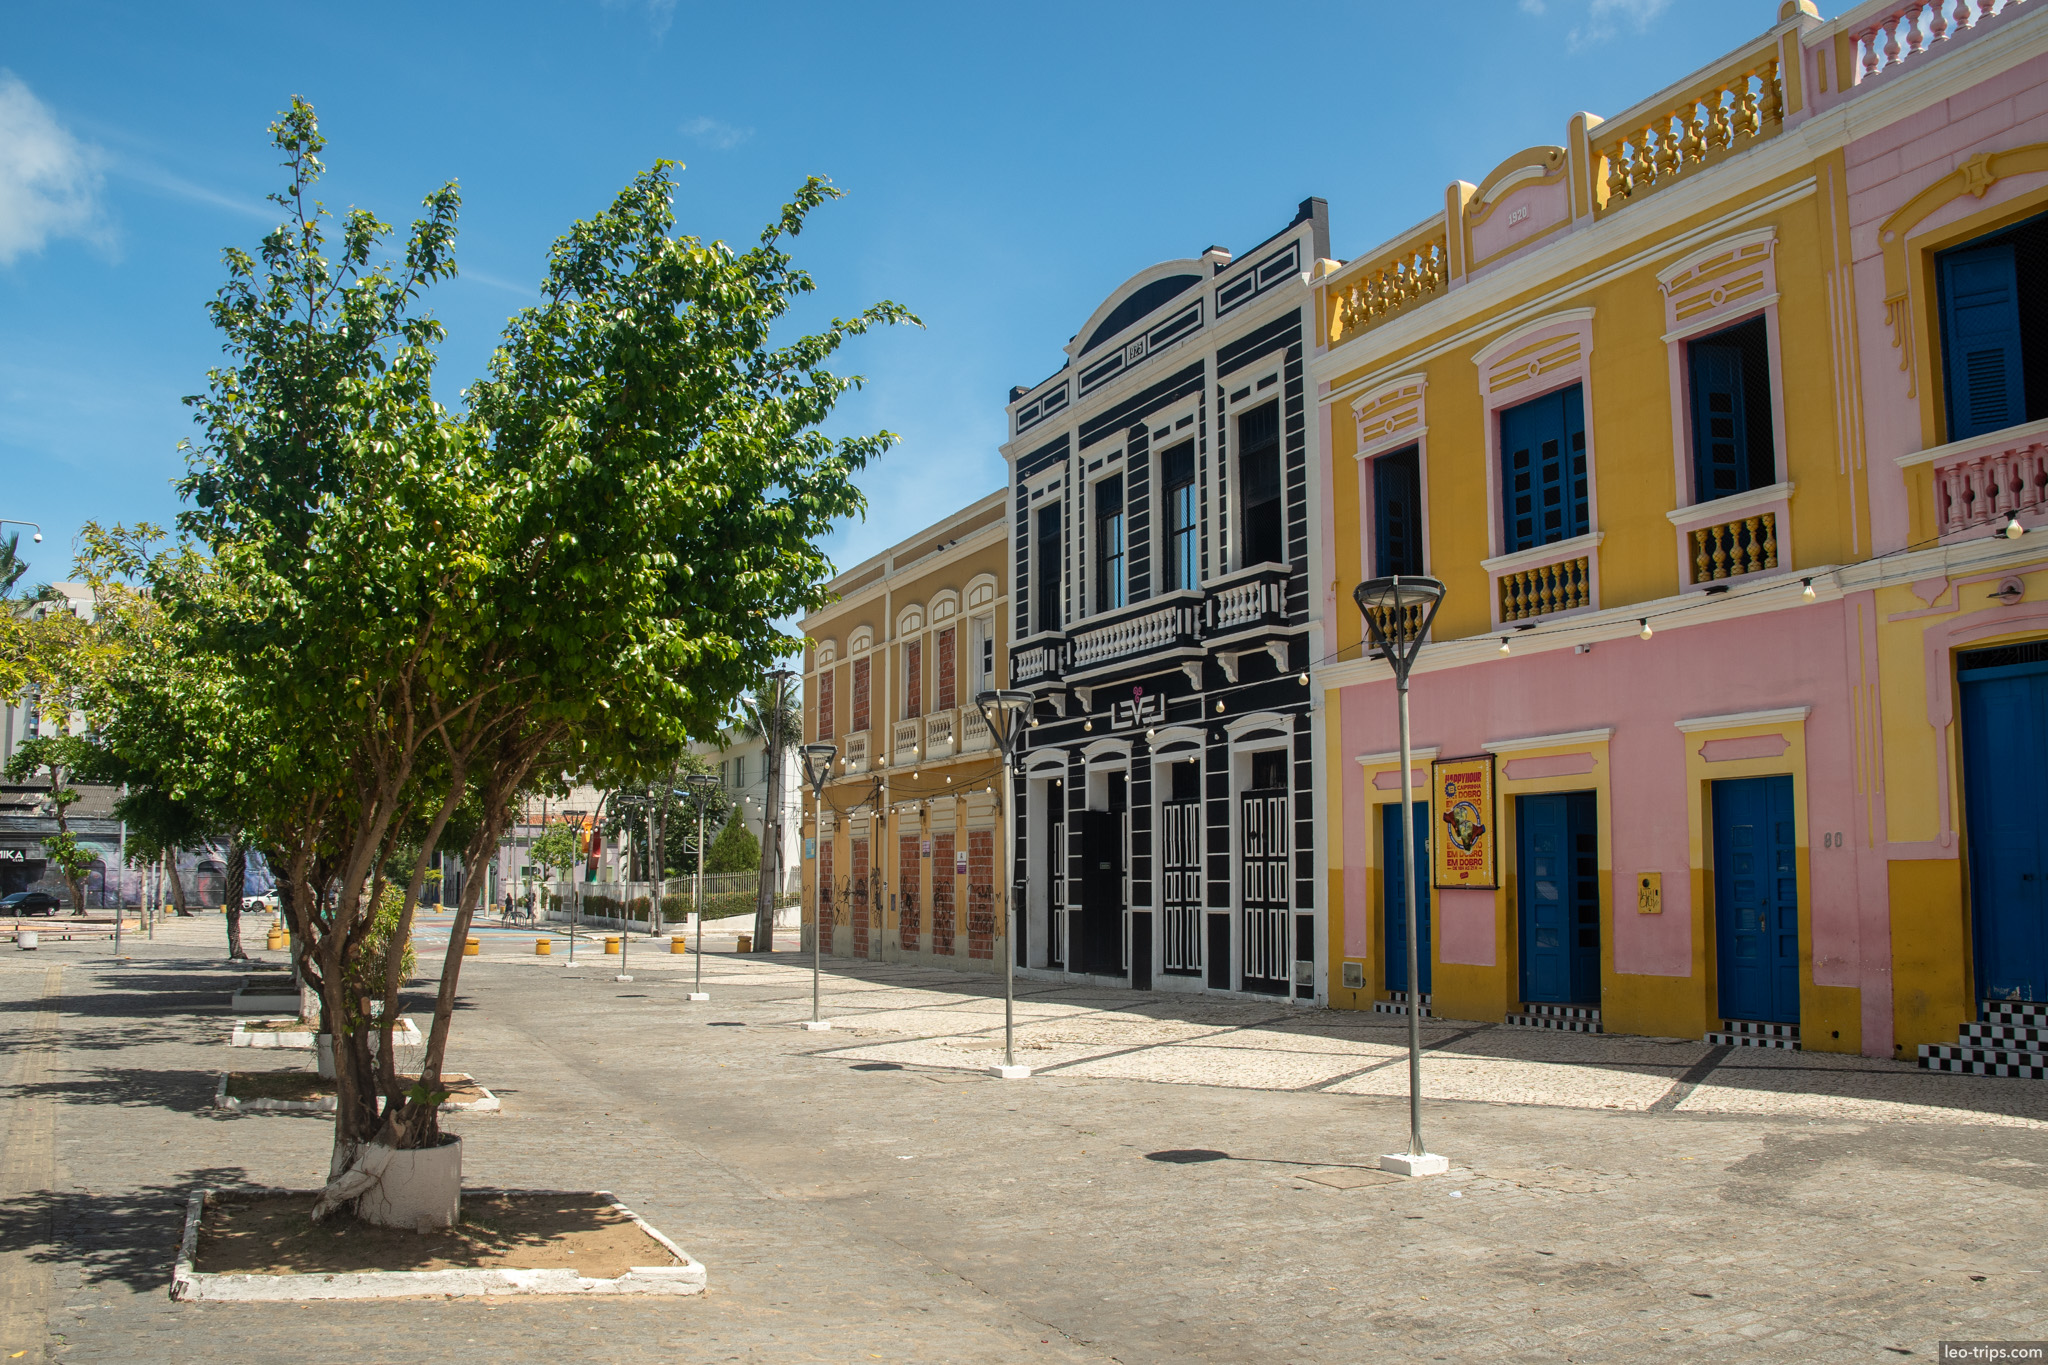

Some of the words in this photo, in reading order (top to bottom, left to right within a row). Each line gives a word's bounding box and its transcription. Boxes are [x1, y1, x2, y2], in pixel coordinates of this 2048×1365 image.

[1509, 206, 1527, 225] 1920
[1111, 693, 1165, 730] LEVEL
[1458, 790, 1482, 798] DOBRO
[1824, 832, 1842, 848] 80
[1459, 858, 1483, 866] DOBRO
